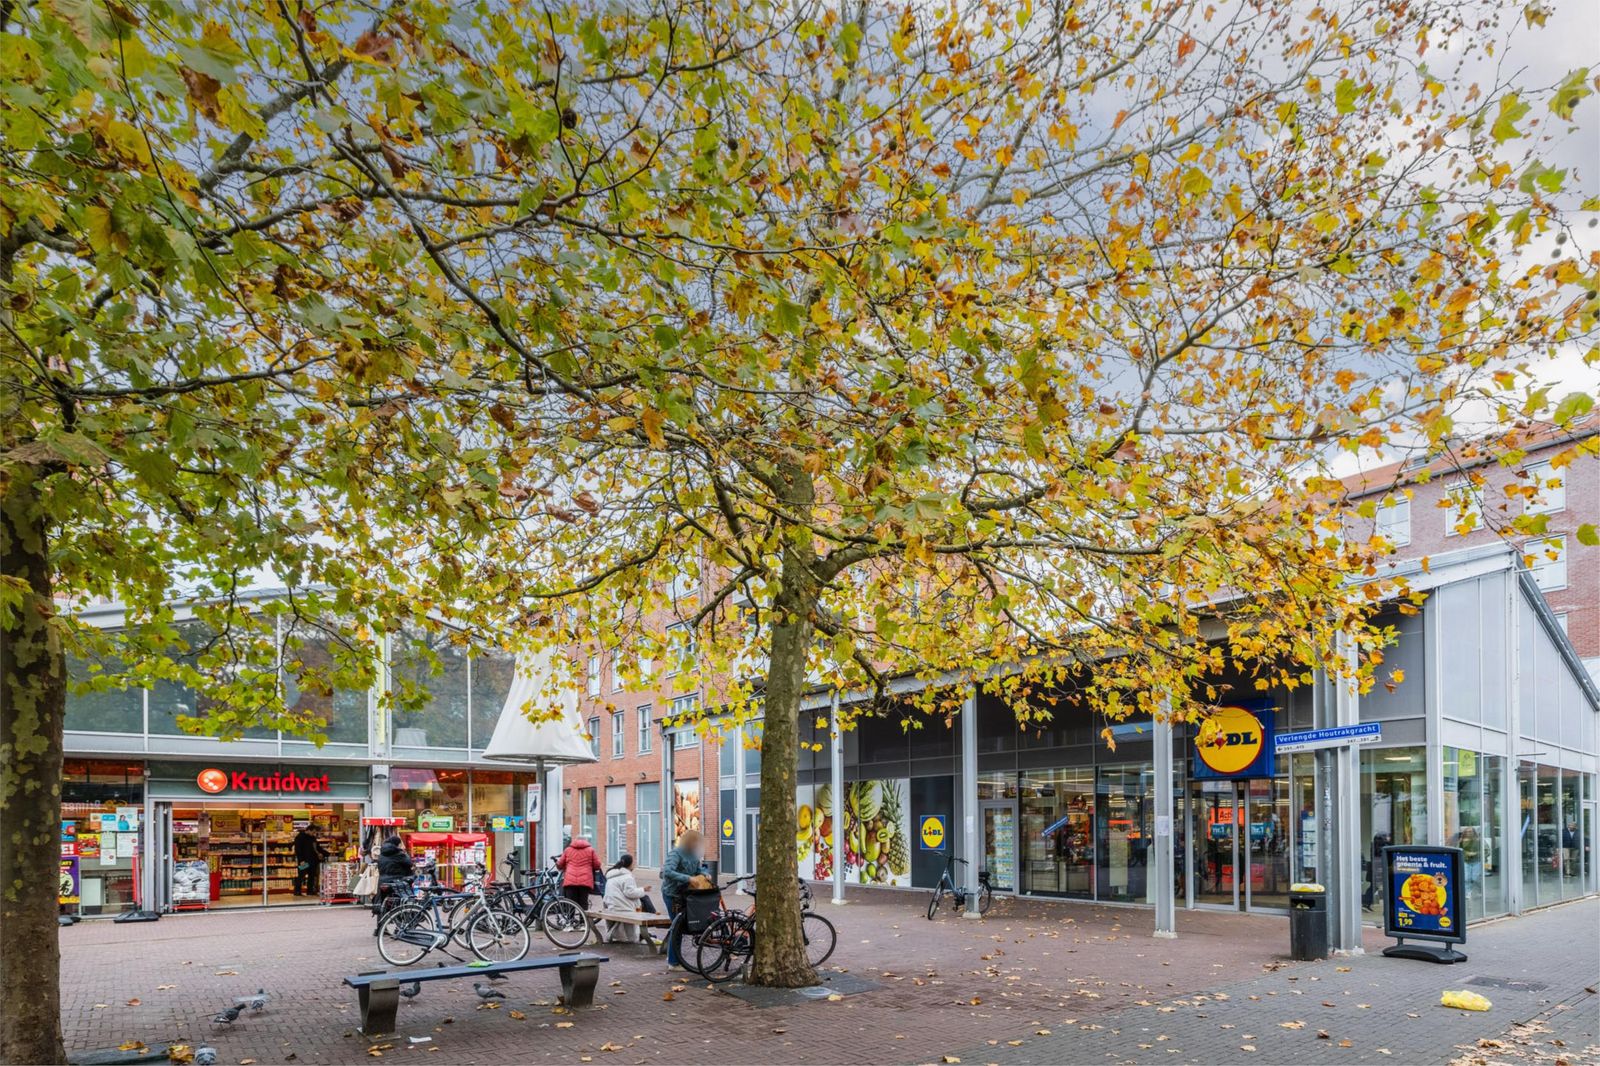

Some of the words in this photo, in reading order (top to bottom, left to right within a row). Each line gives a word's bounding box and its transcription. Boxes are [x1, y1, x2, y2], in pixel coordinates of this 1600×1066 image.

[1205, 731, 1257, 749] IDL
[1279, 733, 1316, 742] Verlengde
[1319, 725, 1376, 737] Houtrakgracht
[231, 771, 330, 792] Kruidvat
